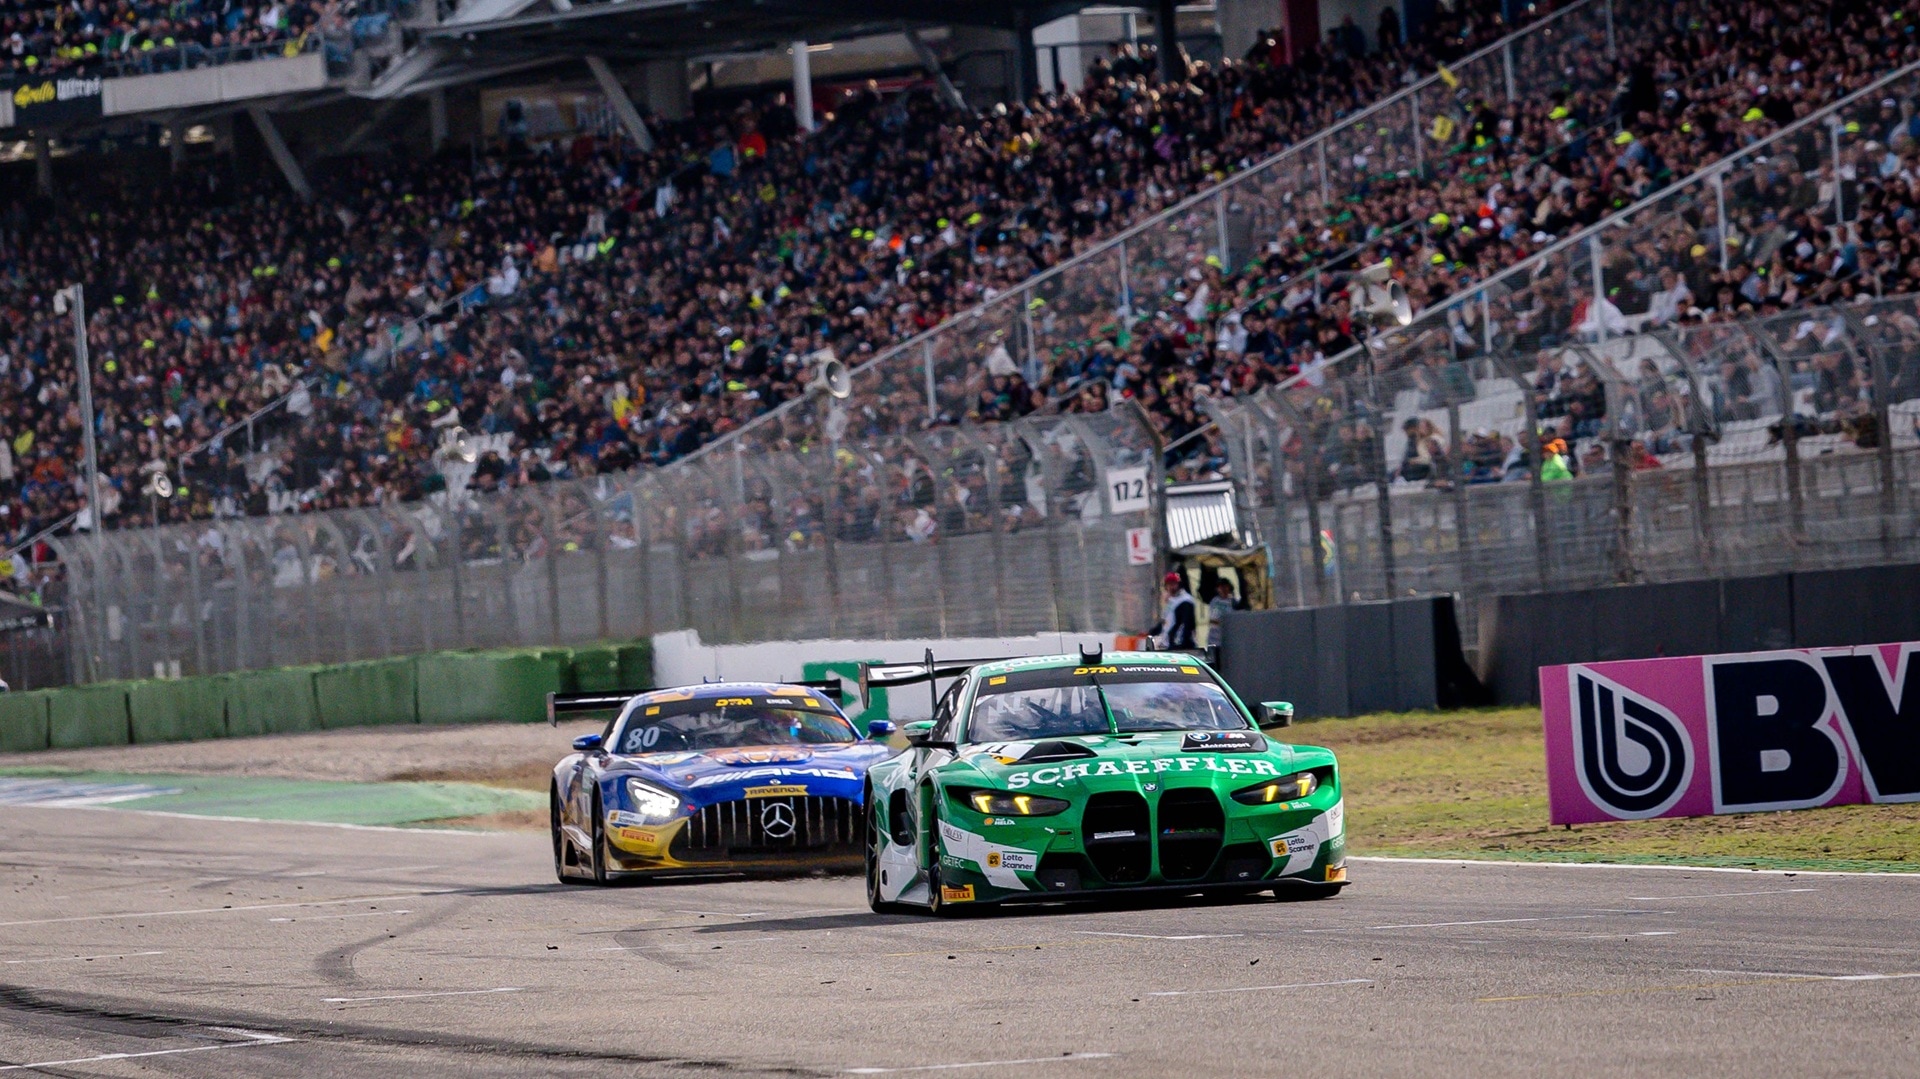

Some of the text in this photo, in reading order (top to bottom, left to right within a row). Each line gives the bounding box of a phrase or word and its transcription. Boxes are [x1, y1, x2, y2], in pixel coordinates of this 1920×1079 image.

[1114, 480, 1144, 501] 17.2
[1074, 667, 1118, 675] DTM
[715, 698, 753, 706] DTM
[626, 726, 660, 750] 80
[1007, 757, 1281, 789] SCHAEFFLER
[622, 830, 655, 842] PIRELLI
[1287, 838, 1305, 846] Lotto
[1288, 844, 1315, 853] Scanner
[943, 855, 964, 869] GETEC
[1002, 853, 1023, 862] Lotto
[1002, 861, 1033, 870] Scanner
[944, 887, 970, 899] PIRELLI
